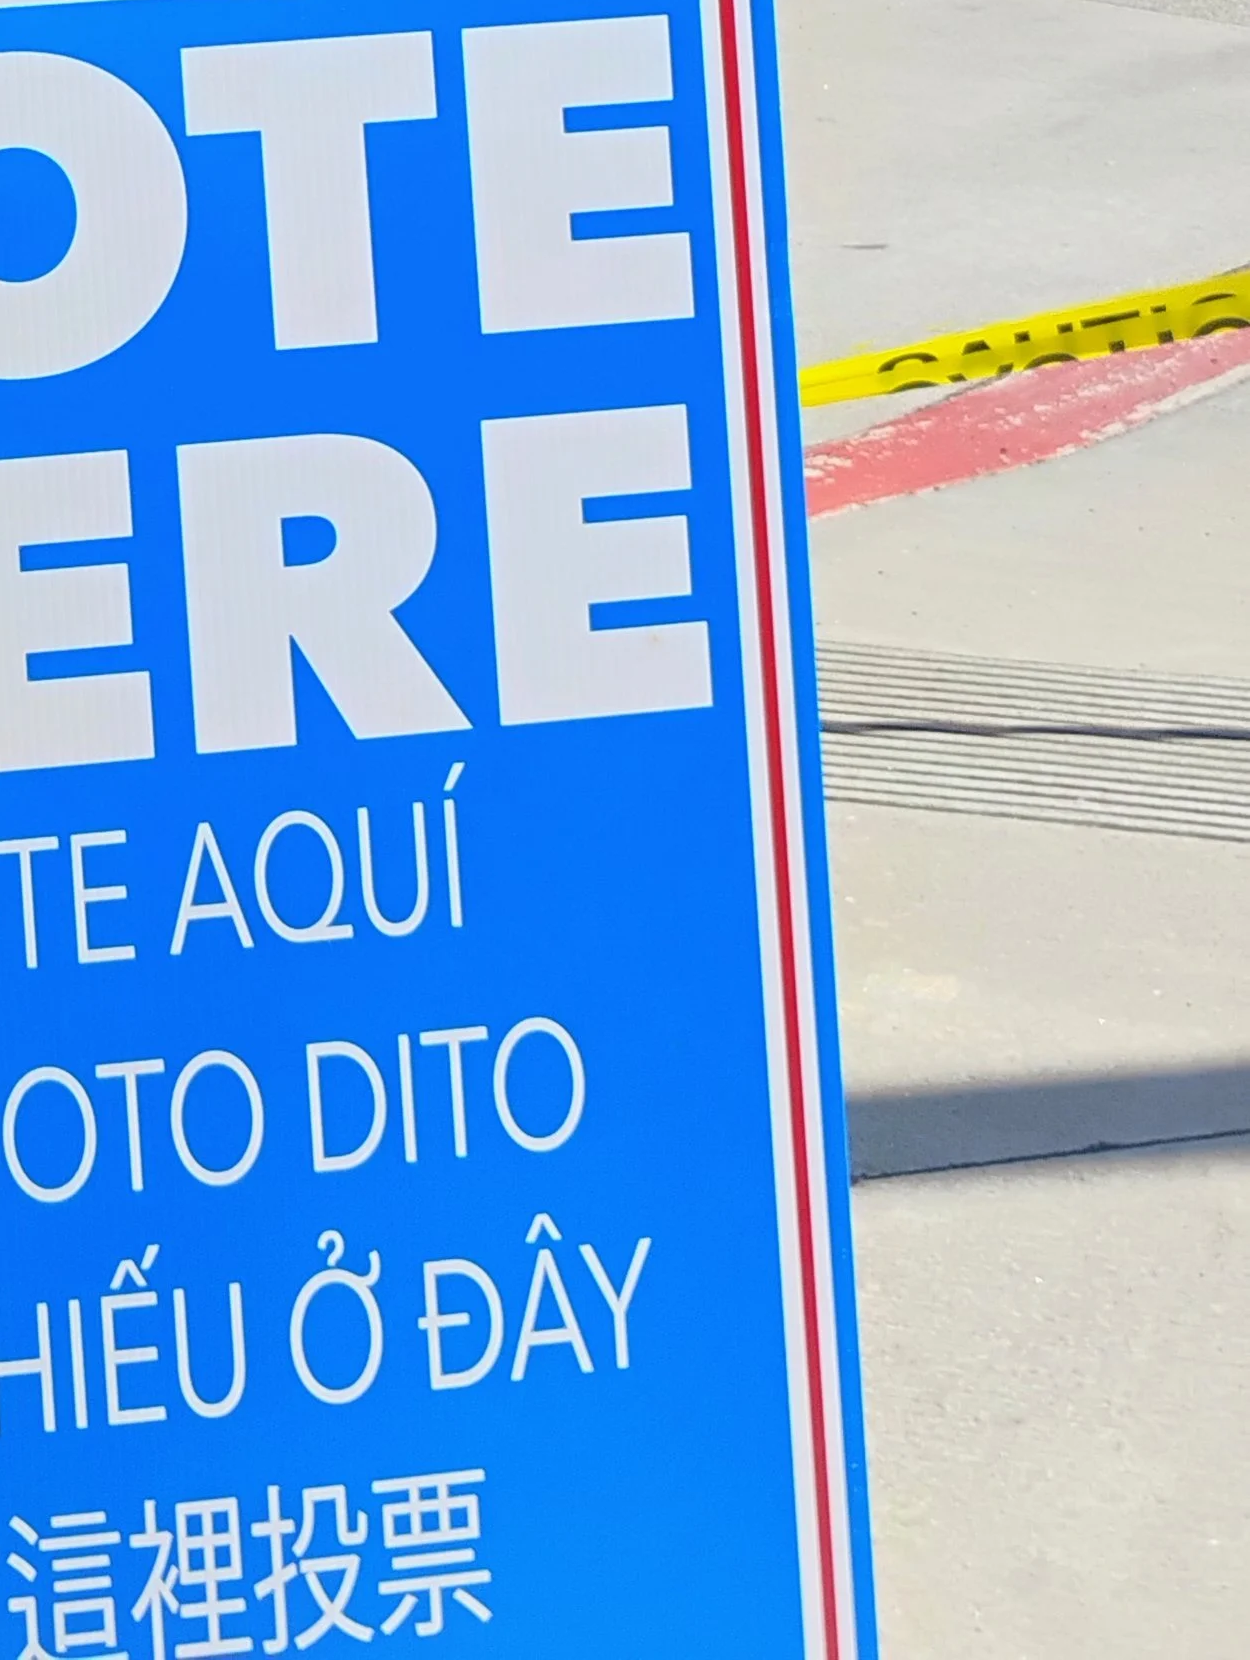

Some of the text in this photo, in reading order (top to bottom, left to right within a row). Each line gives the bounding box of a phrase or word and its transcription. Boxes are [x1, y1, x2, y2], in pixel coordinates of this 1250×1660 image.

[171, 762, 465, 955] AQUÍ
[307, 1017, 586, 1172] DITO
[290, 1229, 383, 1404] Ở
[418, 1212, 652, 1390] ĐÂY
